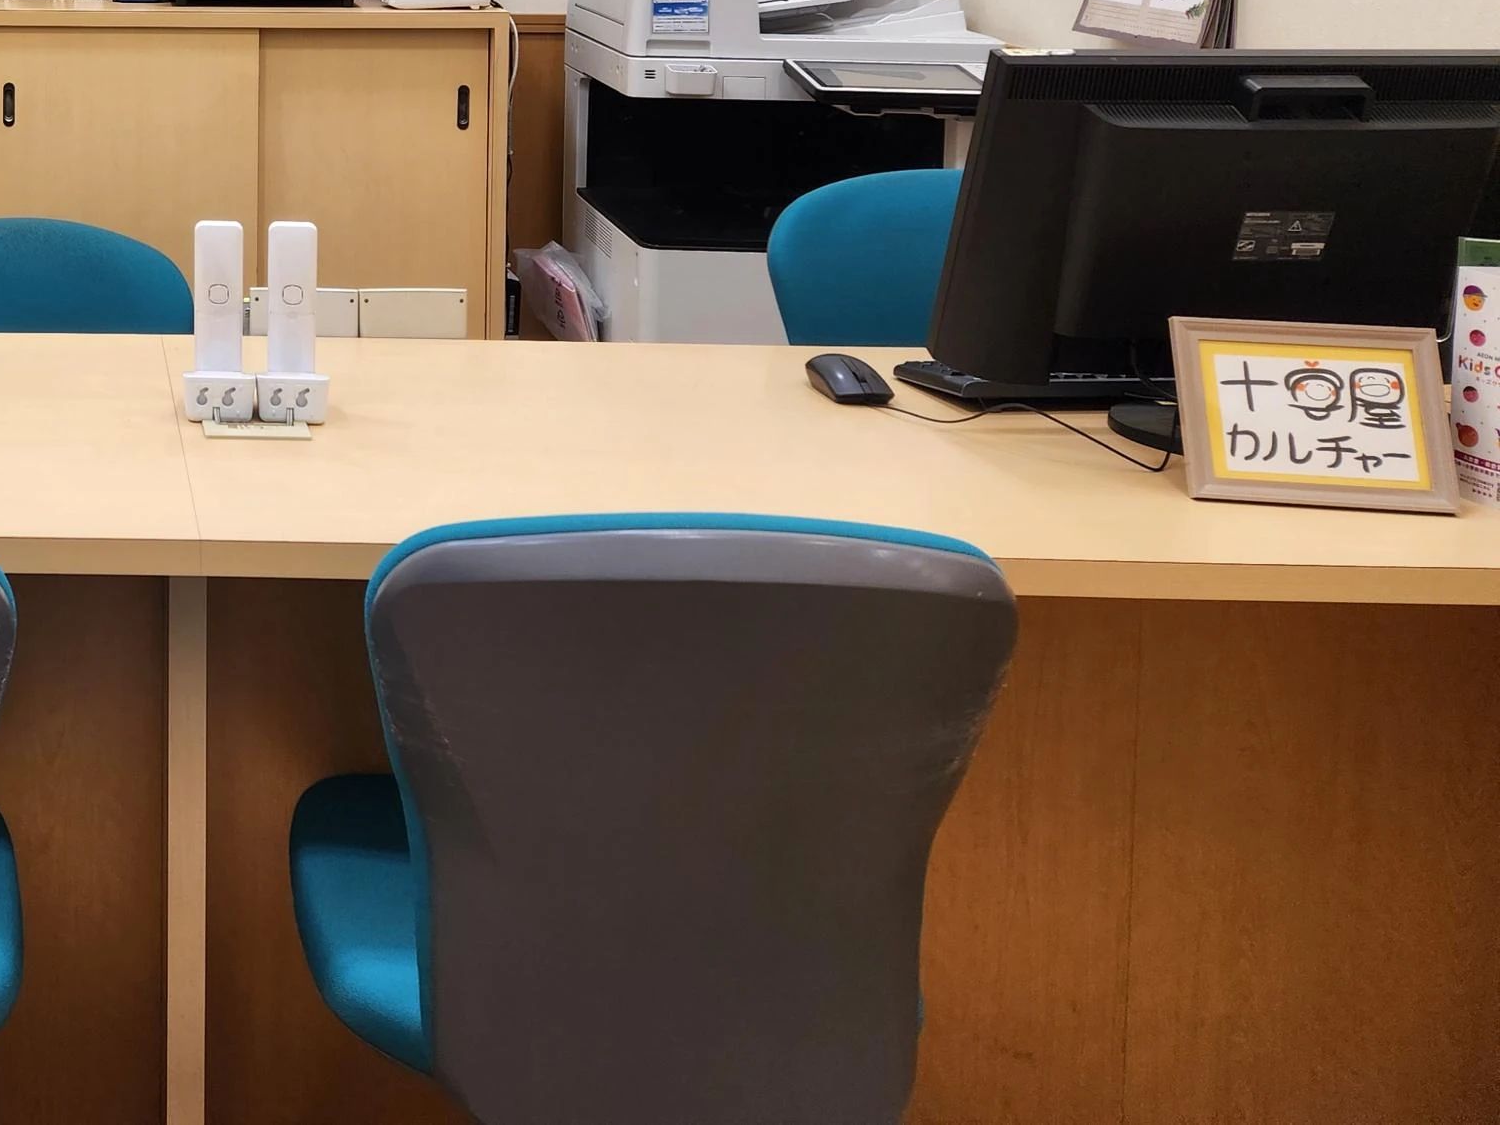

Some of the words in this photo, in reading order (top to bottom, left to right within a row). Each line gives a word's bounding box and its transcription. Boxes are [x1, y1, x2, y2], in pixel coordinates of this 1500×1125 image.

[1458, 355, 1491, 375] Kids
[1226, 423, 1412, 473] カルチャー
